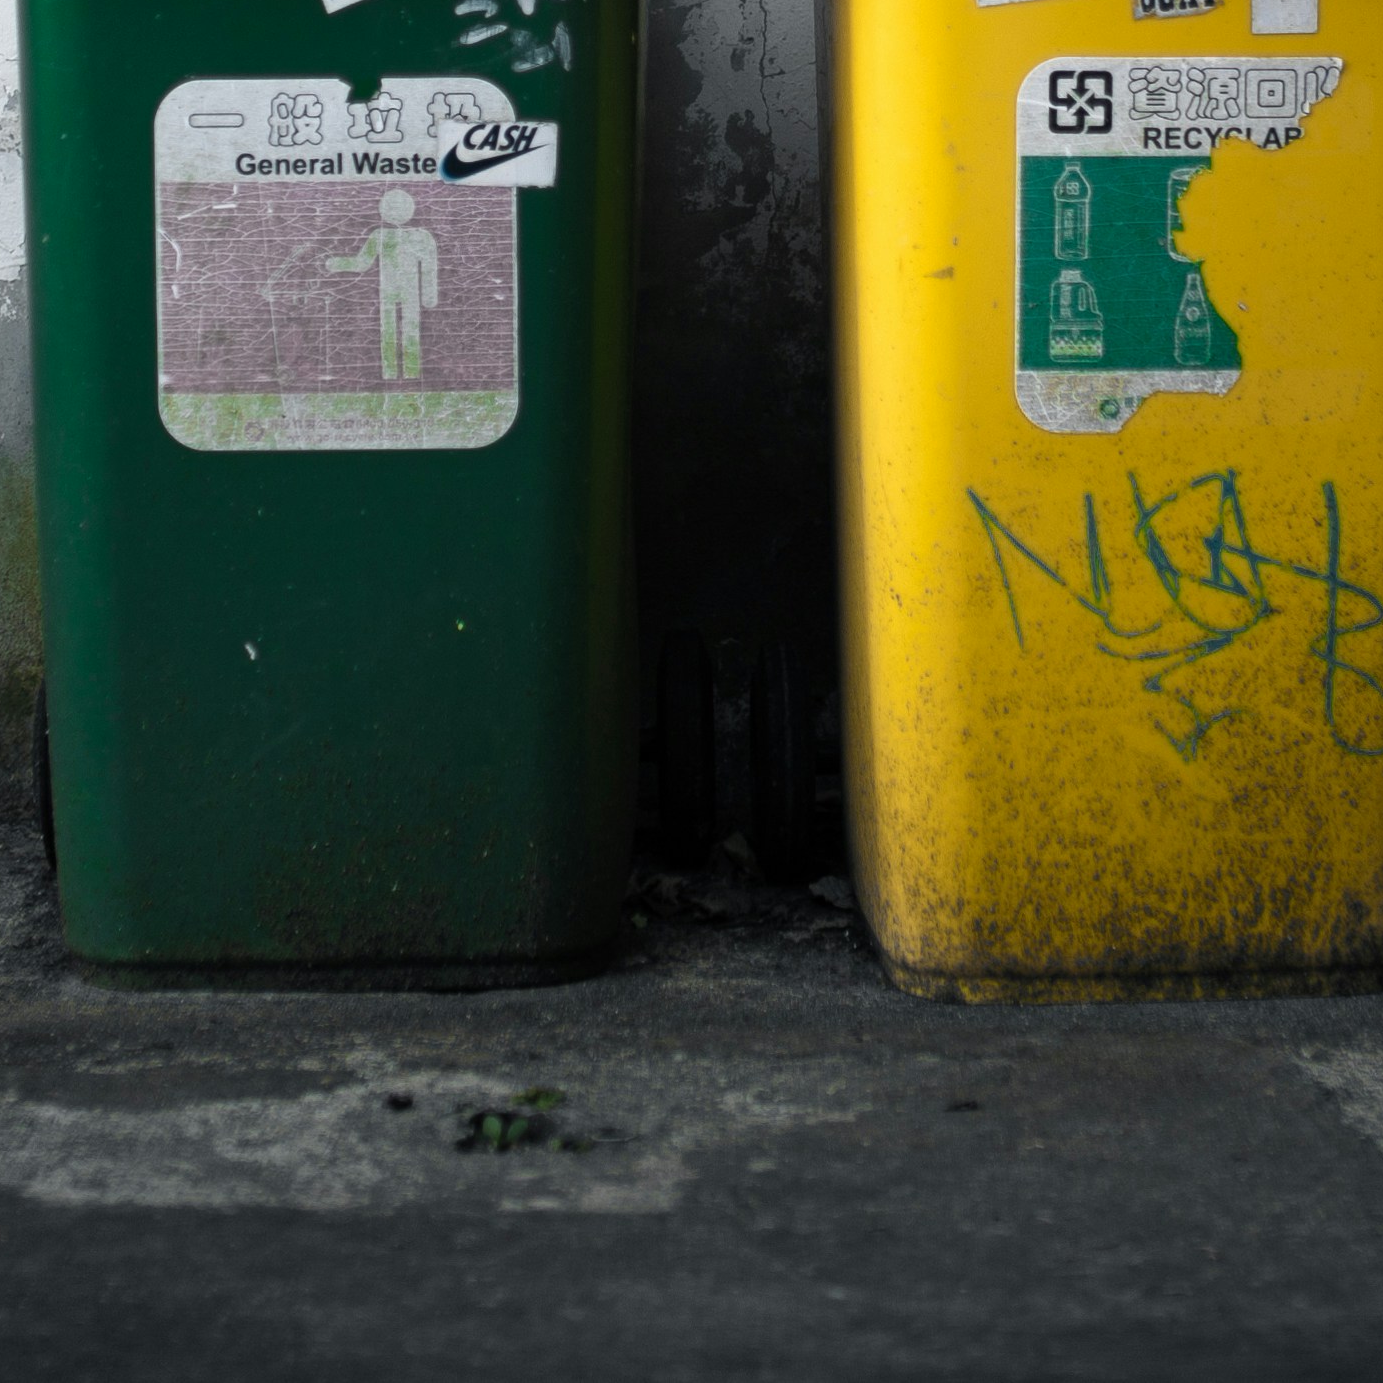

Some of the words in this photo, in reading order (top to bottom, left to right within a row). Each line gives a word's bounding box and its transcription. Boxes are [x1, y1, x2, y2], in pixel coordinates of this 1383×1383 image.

[462, 123, 539, 153] CASH
[234, 152, 344, 176] General
[352, 153, 437, 175] Waste
